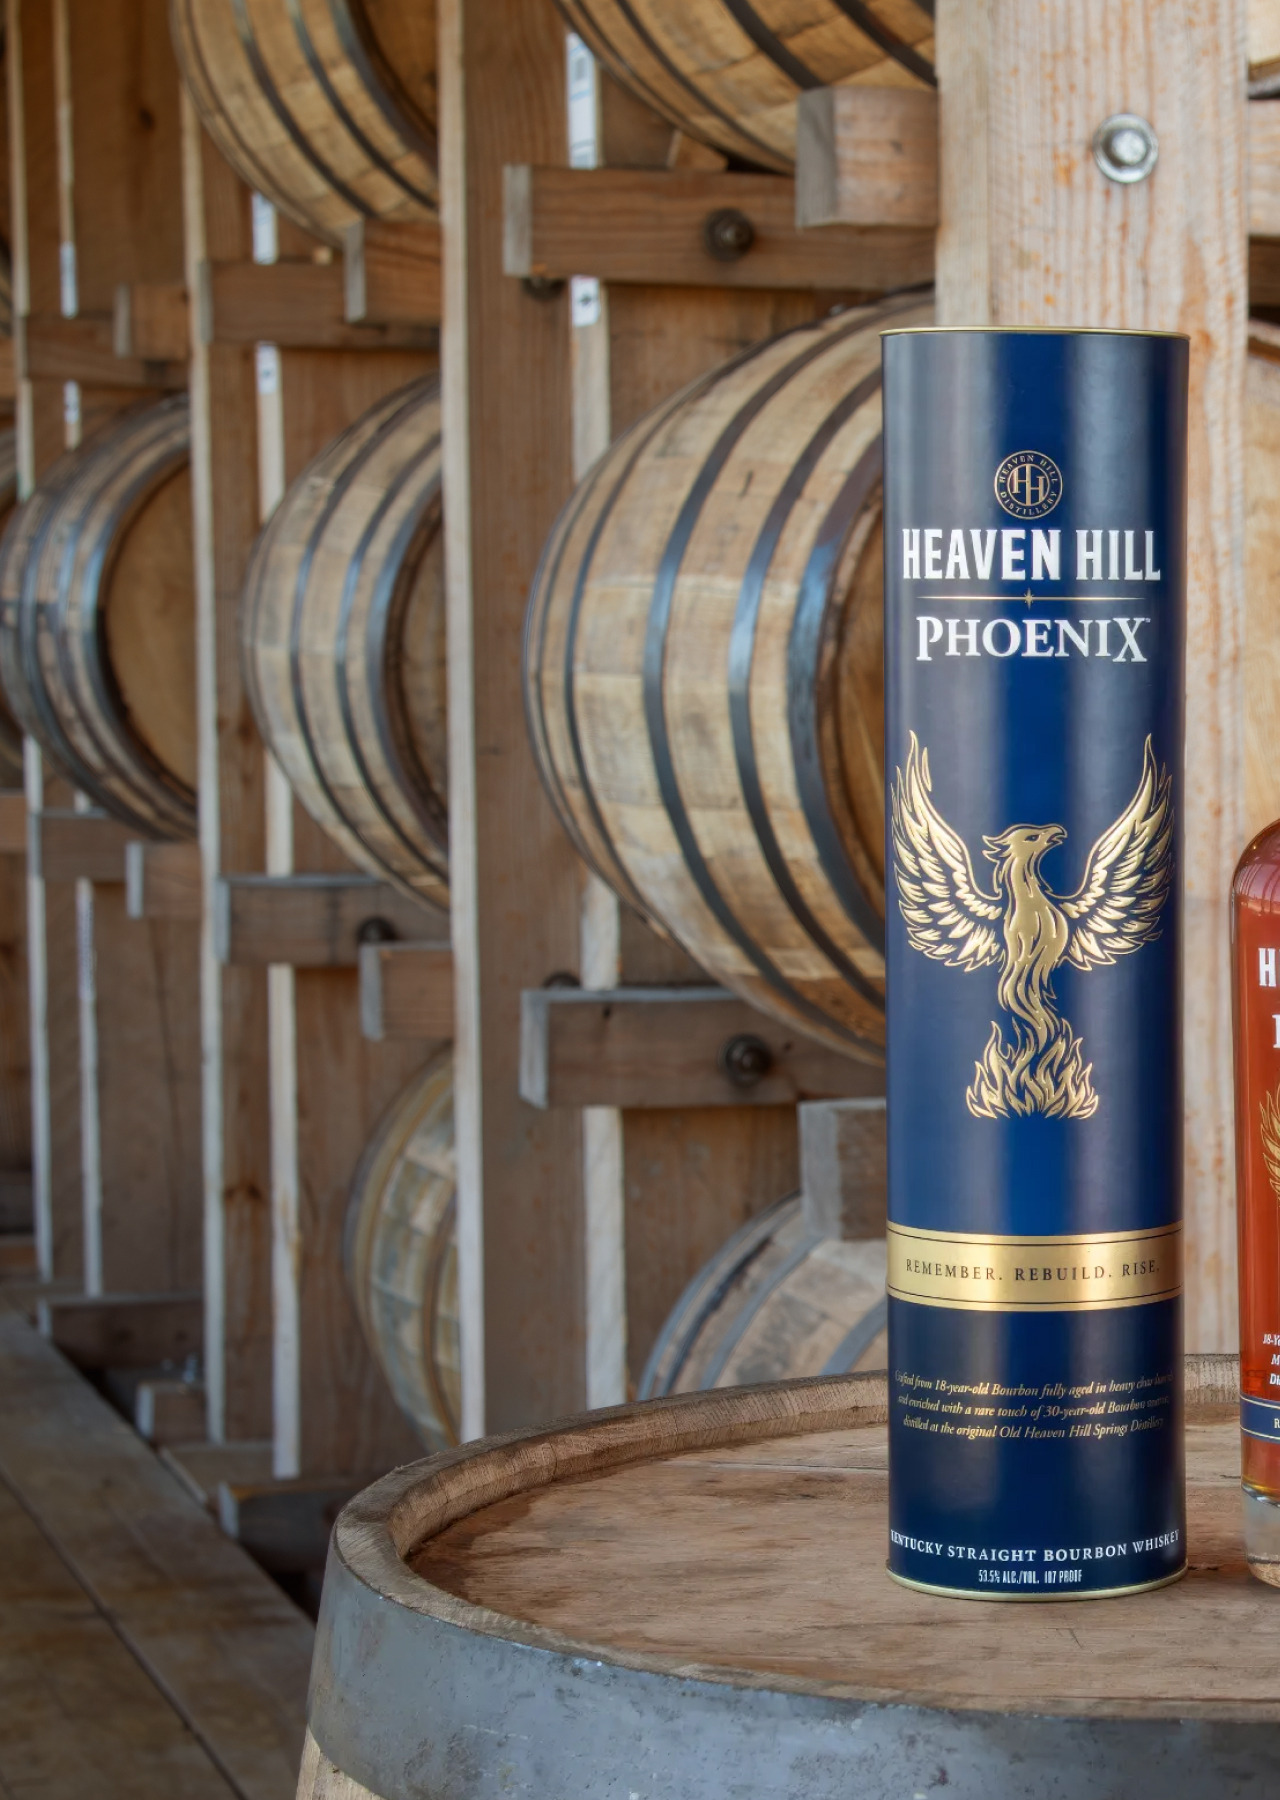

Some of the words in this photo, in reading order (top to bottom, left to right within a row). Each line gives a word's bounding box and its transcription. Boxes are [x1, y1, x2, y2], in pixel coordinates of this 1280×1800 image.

[999, 455, 1034, 483] HEAVEN
[1040, 459, 1058, 484] HILL
[1000, 491, 1057, 516] DISTILLERY
[902, 528, 1061, 581] HEAVEN
[1075, 529, 1161, 581] HILL
[906, 1258, 1003, 1281] REMEMBER.
[1015, 1265, 1112, 1281] REBUILD.
[1122, 1260, 1160, 1275] RISE.
[912, 1375, 932, 1390] from
[935, 1380, 989, 1395] 18-year-old
[991, 1383, 1038, 1396] Bourbon
[1039, 1383, 1065, 1399] fully
[1068, 1381, 1094, 1398] aged
[1095, 1382, 1107, 1394] in
[1109, 1380, 1135, 1393] heavy
[908, 1398, 940, 1411] enriched
[941, 1401, 963, 1414] with
[965, 1407, 971, 1415] a
[974, 1407, 996, 1416] rare
[998, 1405, 1027, 1417] touch
[1031, 1405, 1043, 1420] of
[1043, 1402, 1106, 1420] 30-year-old
[1108, 1399, 1146, 1413] Bourbon
[930, 1423, 939, 1432] at
[940, 1421, 955, 1434] the
[956, 1425, 997, 1440] original
[1000, 1426, 1022, 1438] Old
[1024, 1426, 1065, 1438] Heaven
[1069, 1424, 1092, 1438] Hill
[1093, 1423, 1128, 1439] Springs
[947, 1545, 1037, 1561] STRAIGHT
[1043, 1543, 1127, 1561] BOURBON
[1132, 1529, 1180, 1554] WHISKEY
[1044, 1570, 1057, 1584] 107
[1059, 1569, 1082, 1583] PROOF
